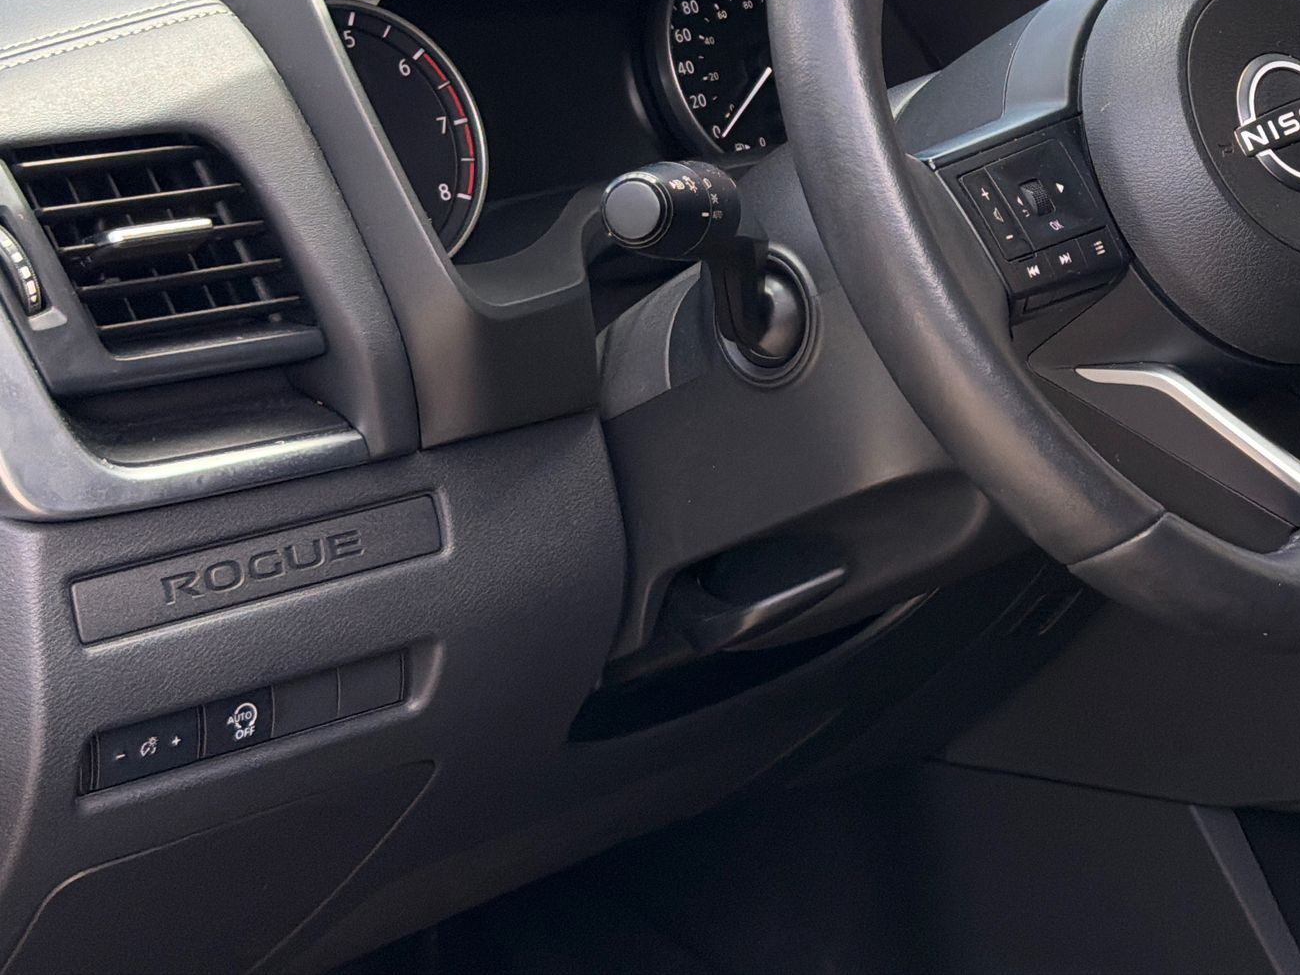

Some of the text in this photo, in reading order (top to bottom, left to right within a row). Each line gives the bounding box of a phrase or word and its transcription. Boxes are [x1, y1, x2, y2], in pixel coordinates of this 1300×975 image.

[681, 0, 699, 15] 80
[742, 0, 754, 9] 80
[717, 10, 727, 20] 60
[343, 30, 355, 48] 5
[674, 28, 692, 43] 60
[704, 36, 715, 45] 40
[399, 58, 411, 76] 6
[678, 60, 695, 75] 40
[708, 72, 719, 81] 20
[689, 93, 707, 109] 20
[436, 116, 446, 134] 7
[438, 183, 451, 201] 8
[1049, 219, 1064, 231] OK
[160, 530, 365, 605] ROGUE
[227, 710, 252, 725] AUTO
[235, 726, 256, 741] OFF
